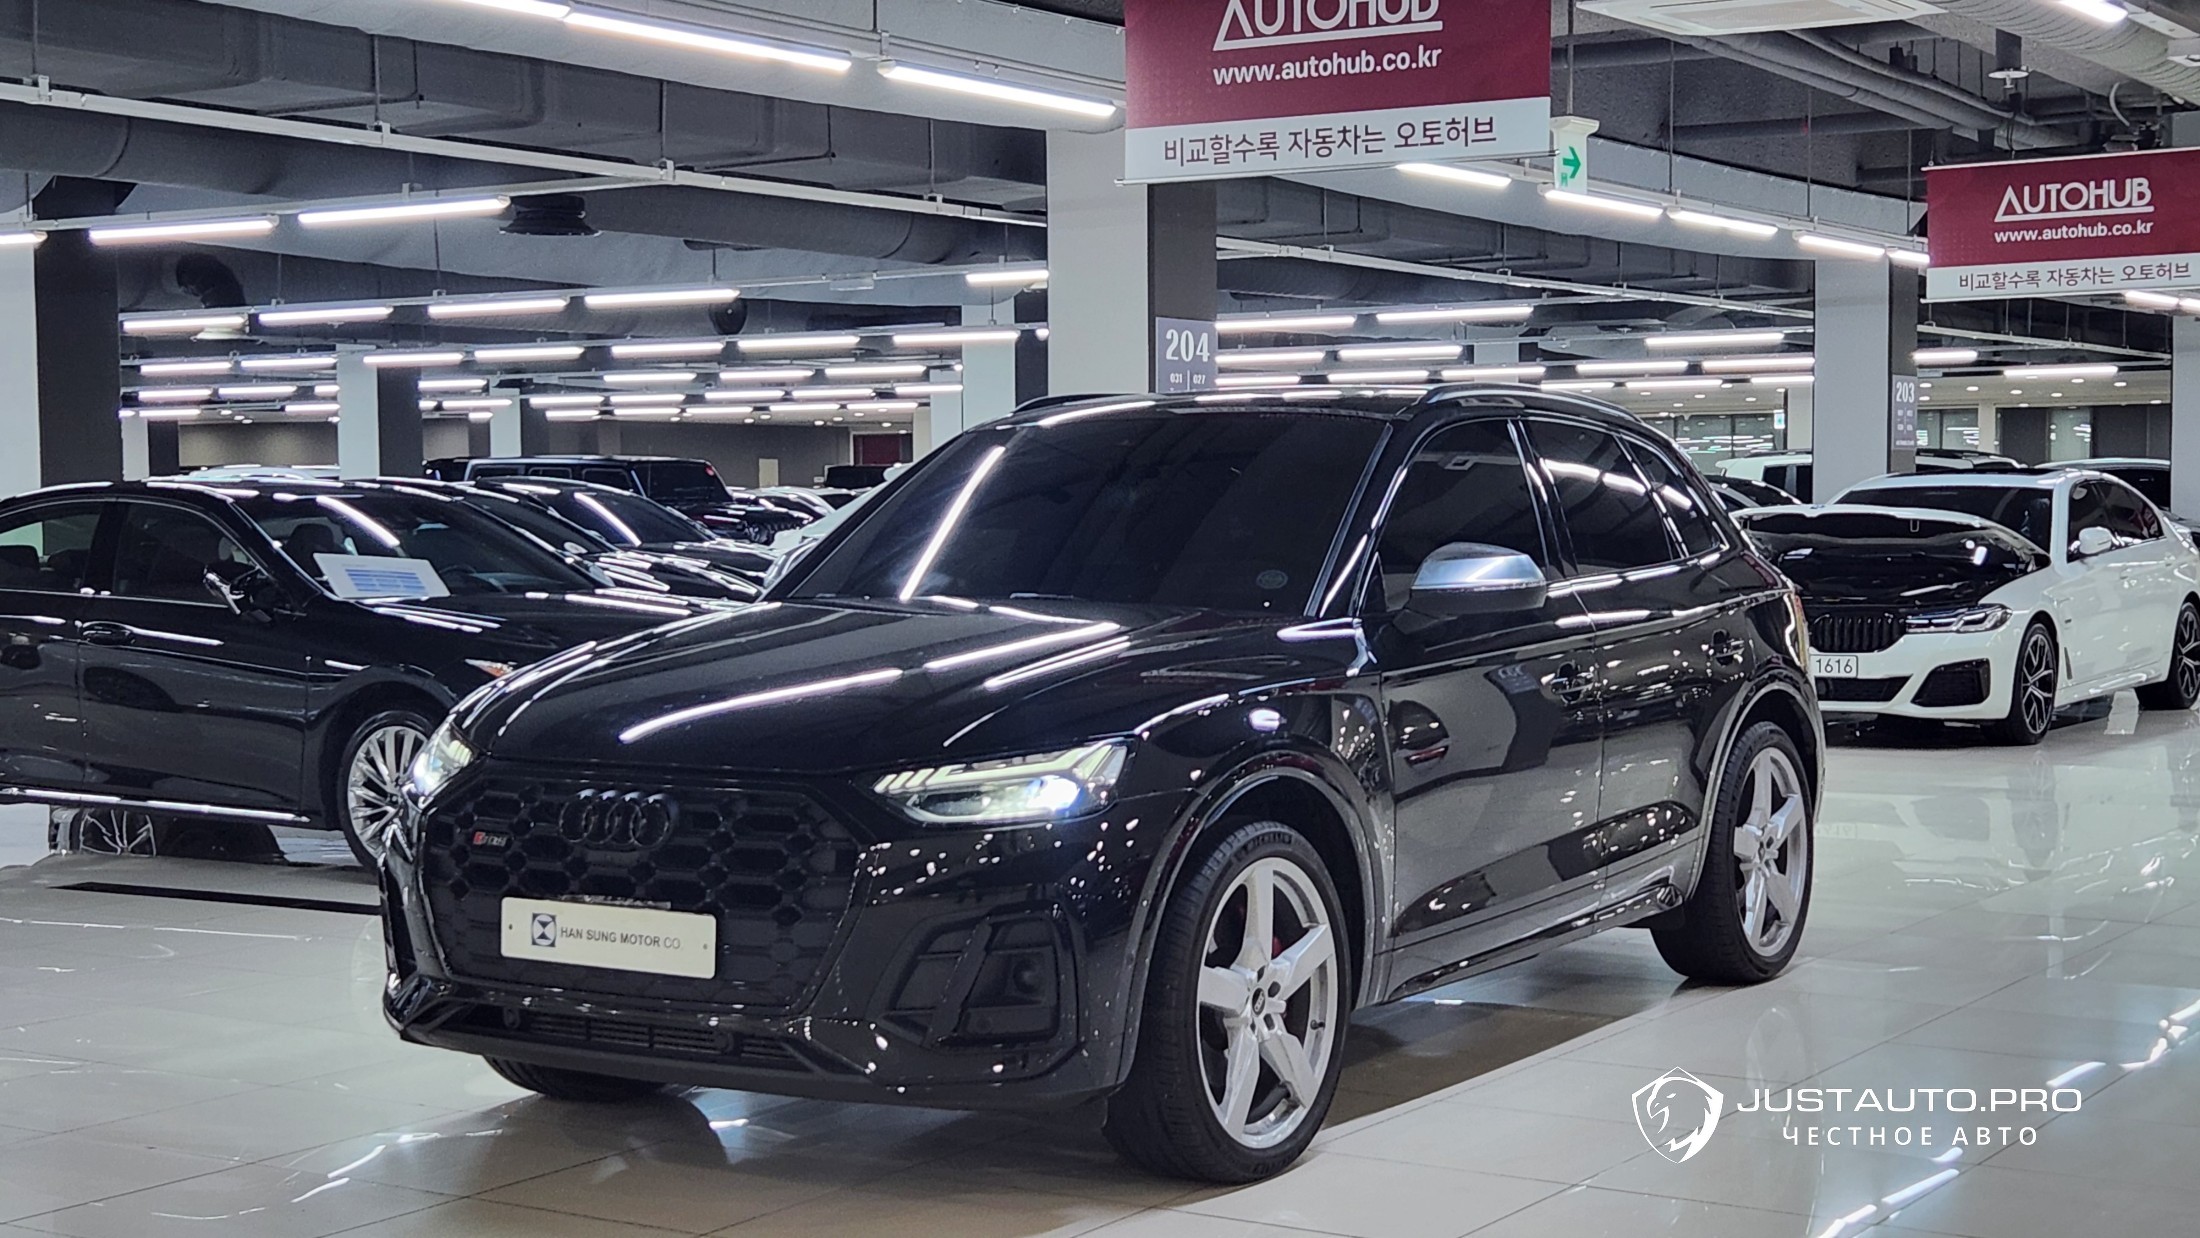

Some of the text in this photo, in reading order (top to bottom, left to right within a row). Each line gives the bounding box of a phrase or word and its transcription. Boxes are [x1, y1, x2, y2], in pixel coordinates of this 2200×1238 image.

[1213, 45, 1443, 85] www.autohub.co.kr
[1164, 116, 1497, 166] 비교할수록 자동차는 오토허브
[1994, 177, 2154, 222] AUTOHUB
[1994, 220, 2153, 243] www.autohub.co.kr
[1959, 261, 2191, 291] 비교할수록 자동차는 오토허브
[1165, 328, 1210, 362] 204
[1170, 372, 1183, 383] 031
[1193, 374, 1206, 385] 027
[1896, 381, 1915, 403] 203
[1815, 658, 1853, 674] 1616
[560, 926, 583, 939] HAN
[586, 929, 617, 942] SUNG
[620, 932, 661, 948] MOTOR
